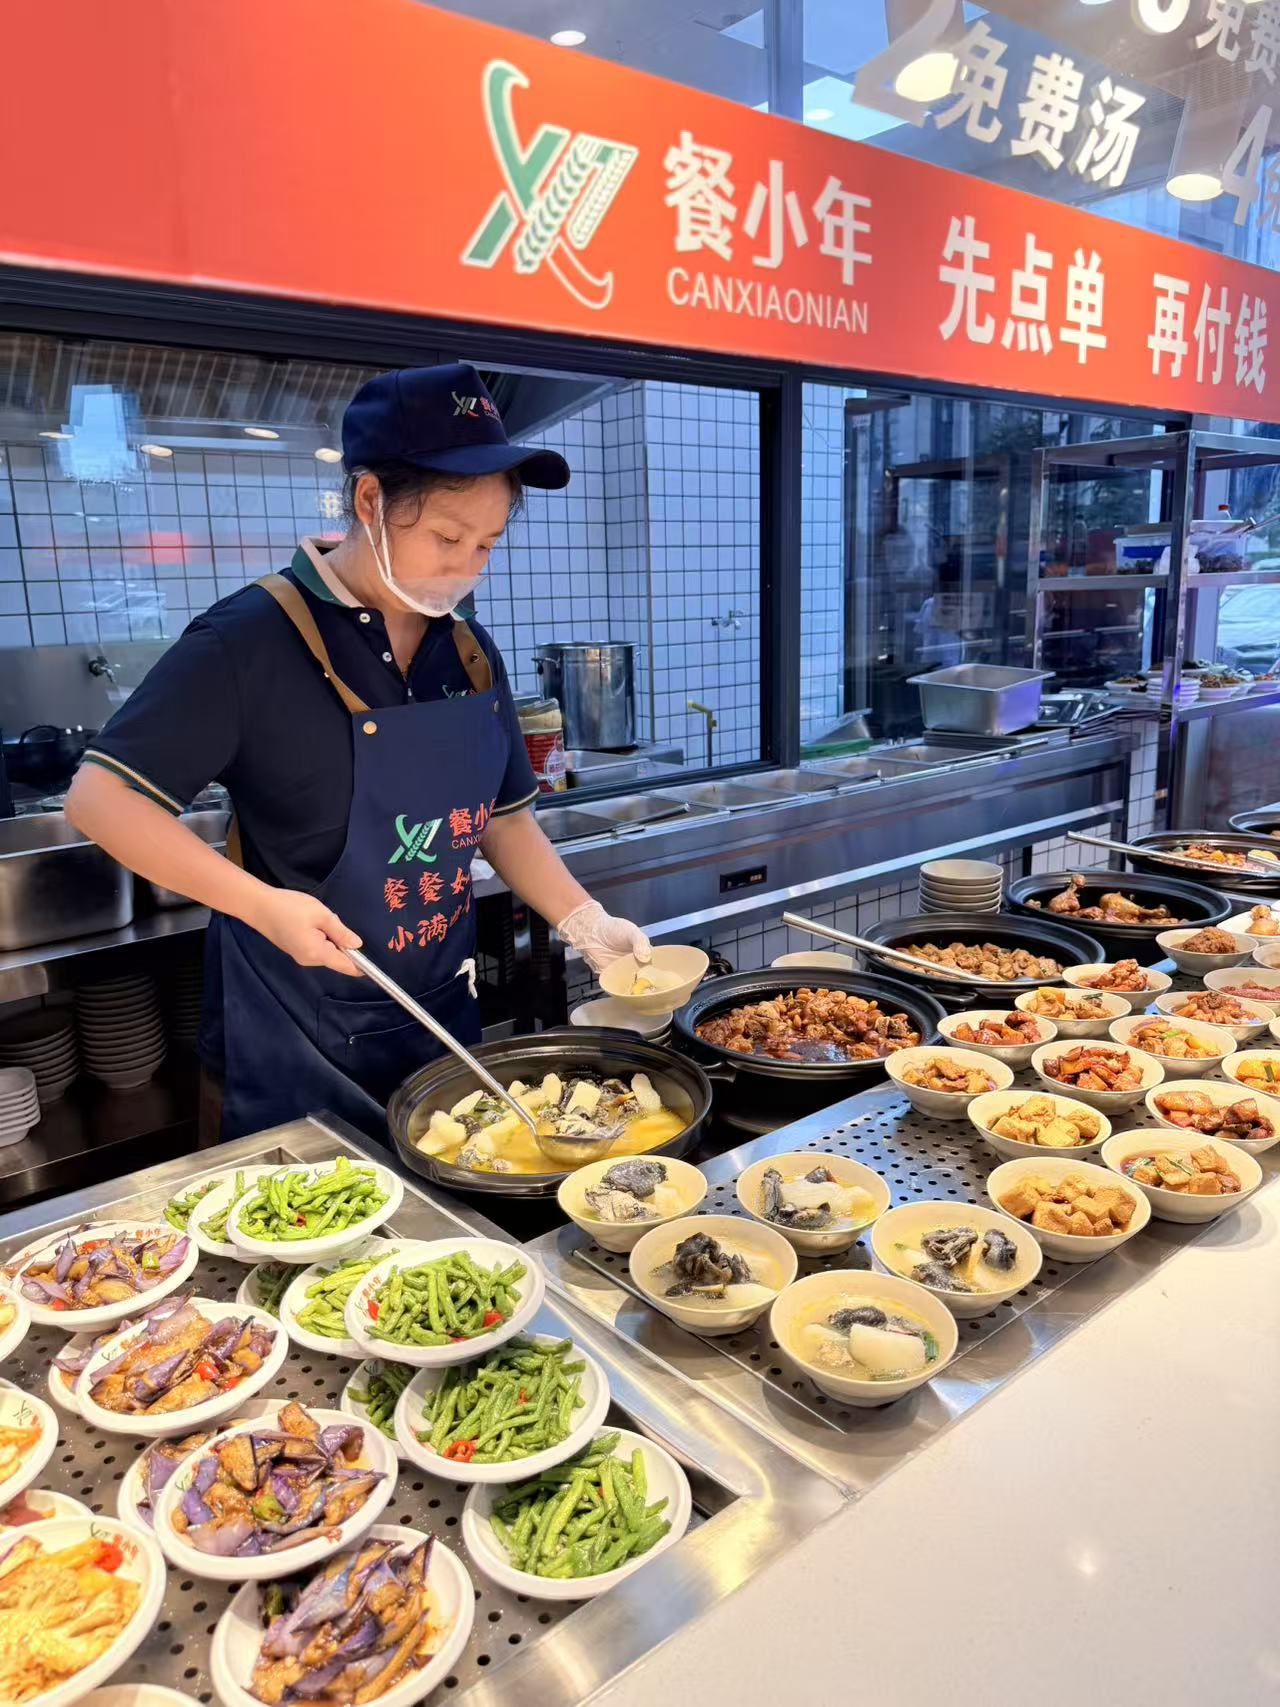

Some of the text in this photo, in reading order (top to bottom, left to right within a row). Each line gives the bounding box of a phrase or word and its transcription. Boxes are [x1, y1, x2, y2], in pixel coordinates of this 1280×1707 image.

[933, 20, 1146, 187] 免费汤
[662, 131, 872, 286] 餐小年
[667, 267, 868, 334] CANXIAONIAN
[939, 215, 1268, 394] 先点单 再付钱
[449, 798, 496, 837] 餐小
